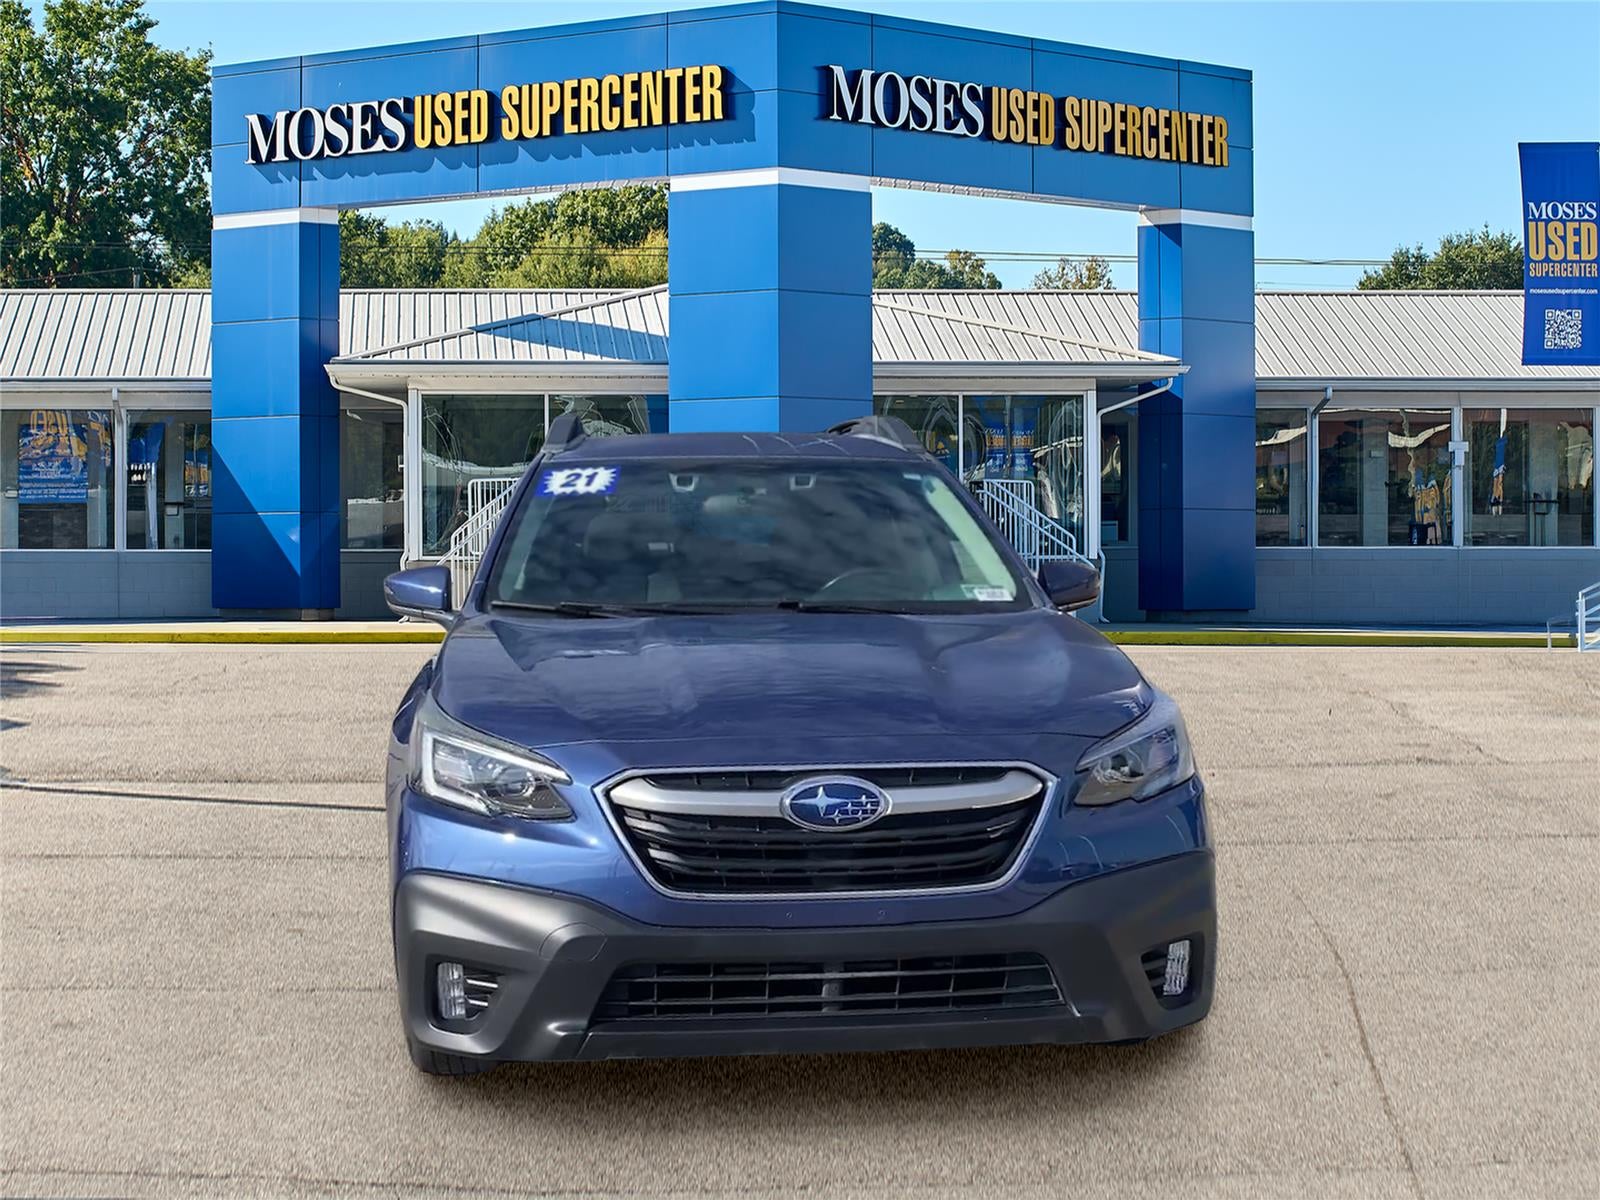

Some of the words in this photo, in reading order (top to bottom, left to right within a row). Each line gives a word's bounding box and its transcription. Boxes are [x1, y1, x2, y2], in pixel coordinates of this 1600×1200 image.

[244, 97, 407, 165] MOSES
[413, 89, 489, 149] USED
[500, 64, 724, 141] SUPERCENTER
[828, 64, 985, 138] MOSES
[991, 86, 1055, 146] USED
[1065, 95, 1229, 167] SUPERCENTER
[1527, 201, 1598, 220] MOSES
[1528, 221, 1598, 261] USED
[1529, 262, 1598, 278] SUPERCENTER
[560, 471, 599, 489] 21
